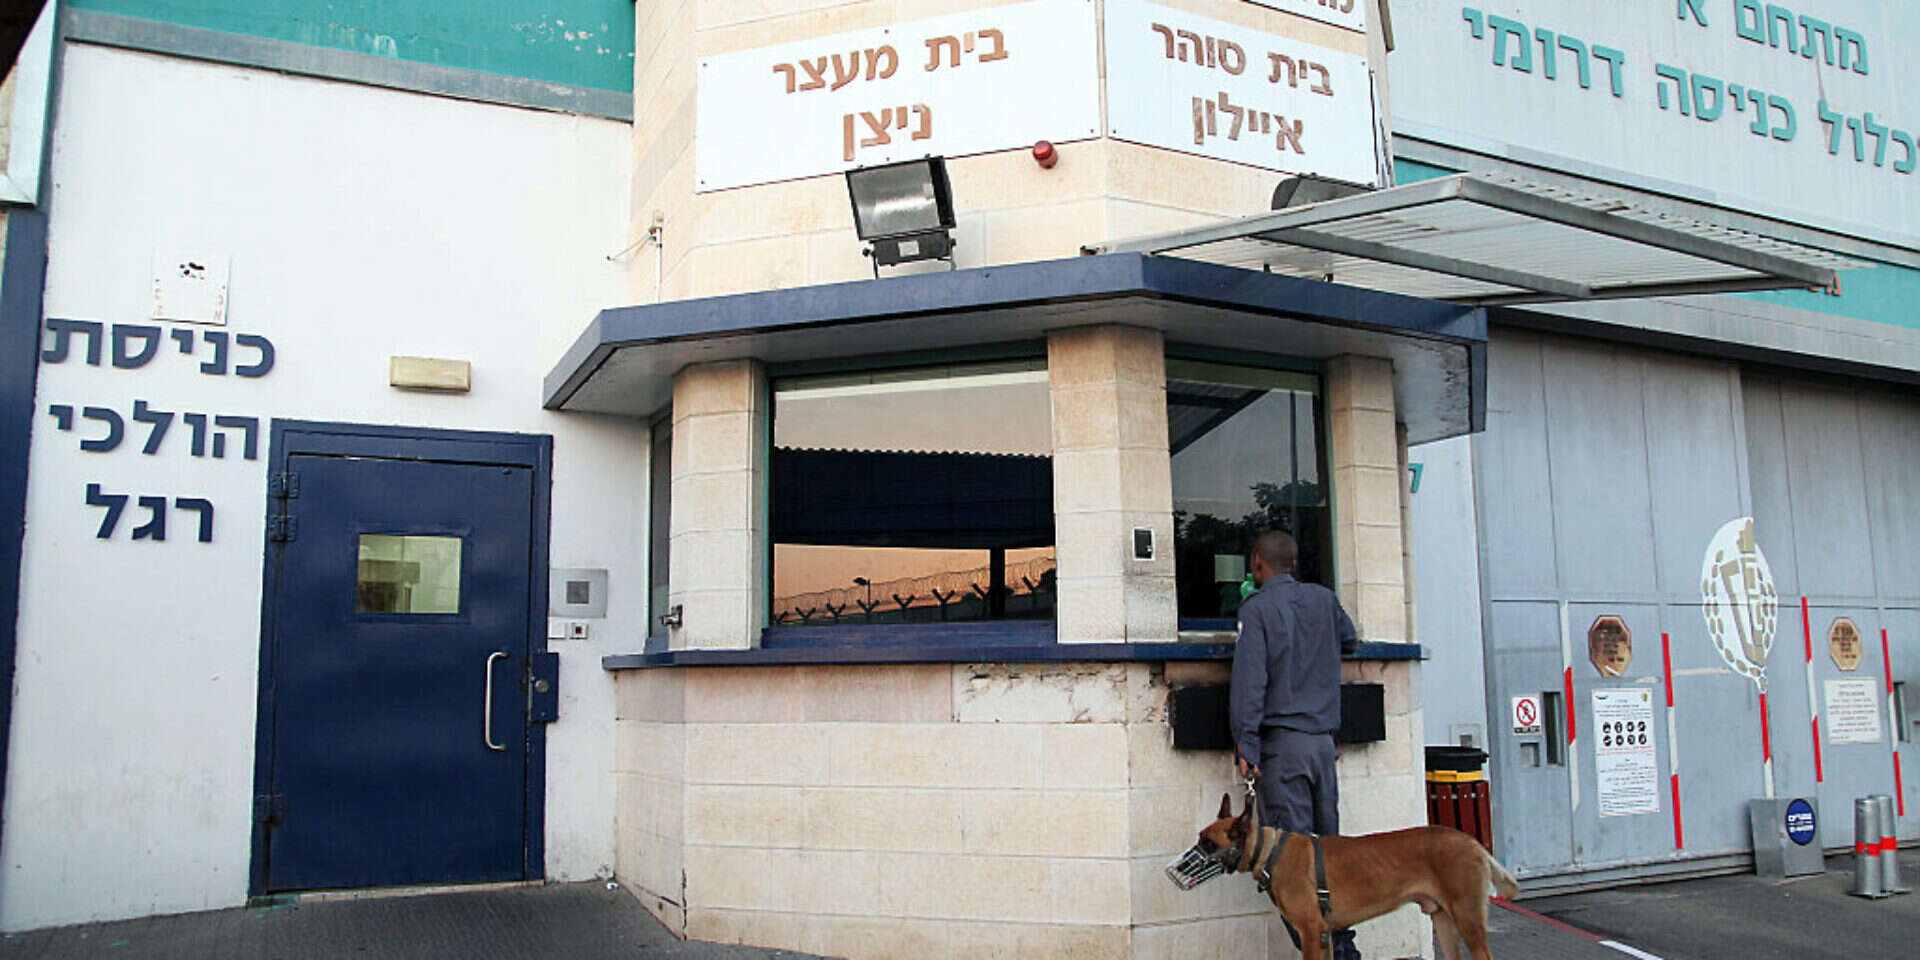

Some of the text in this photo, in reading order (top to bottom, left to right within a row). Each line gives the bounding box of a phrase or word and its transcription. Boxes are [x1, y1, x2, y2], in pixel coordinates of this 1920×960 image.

[772, 28, 1009, 95] בית מעצר
[1151, 23, 1334, 97] בית סוהר
[1735, 0, 1870, 75] מתחם
[1462, 6, 1920, 175] כלול כניסה דרומי
[842, 102, 933, 163] ניצן
[1191, 92, 1306, 154] איילון
[42, 318, 276, 379] כניסת
[48, 399, 260, 461] הולכי
[85, 483, 215, 543] רגל
